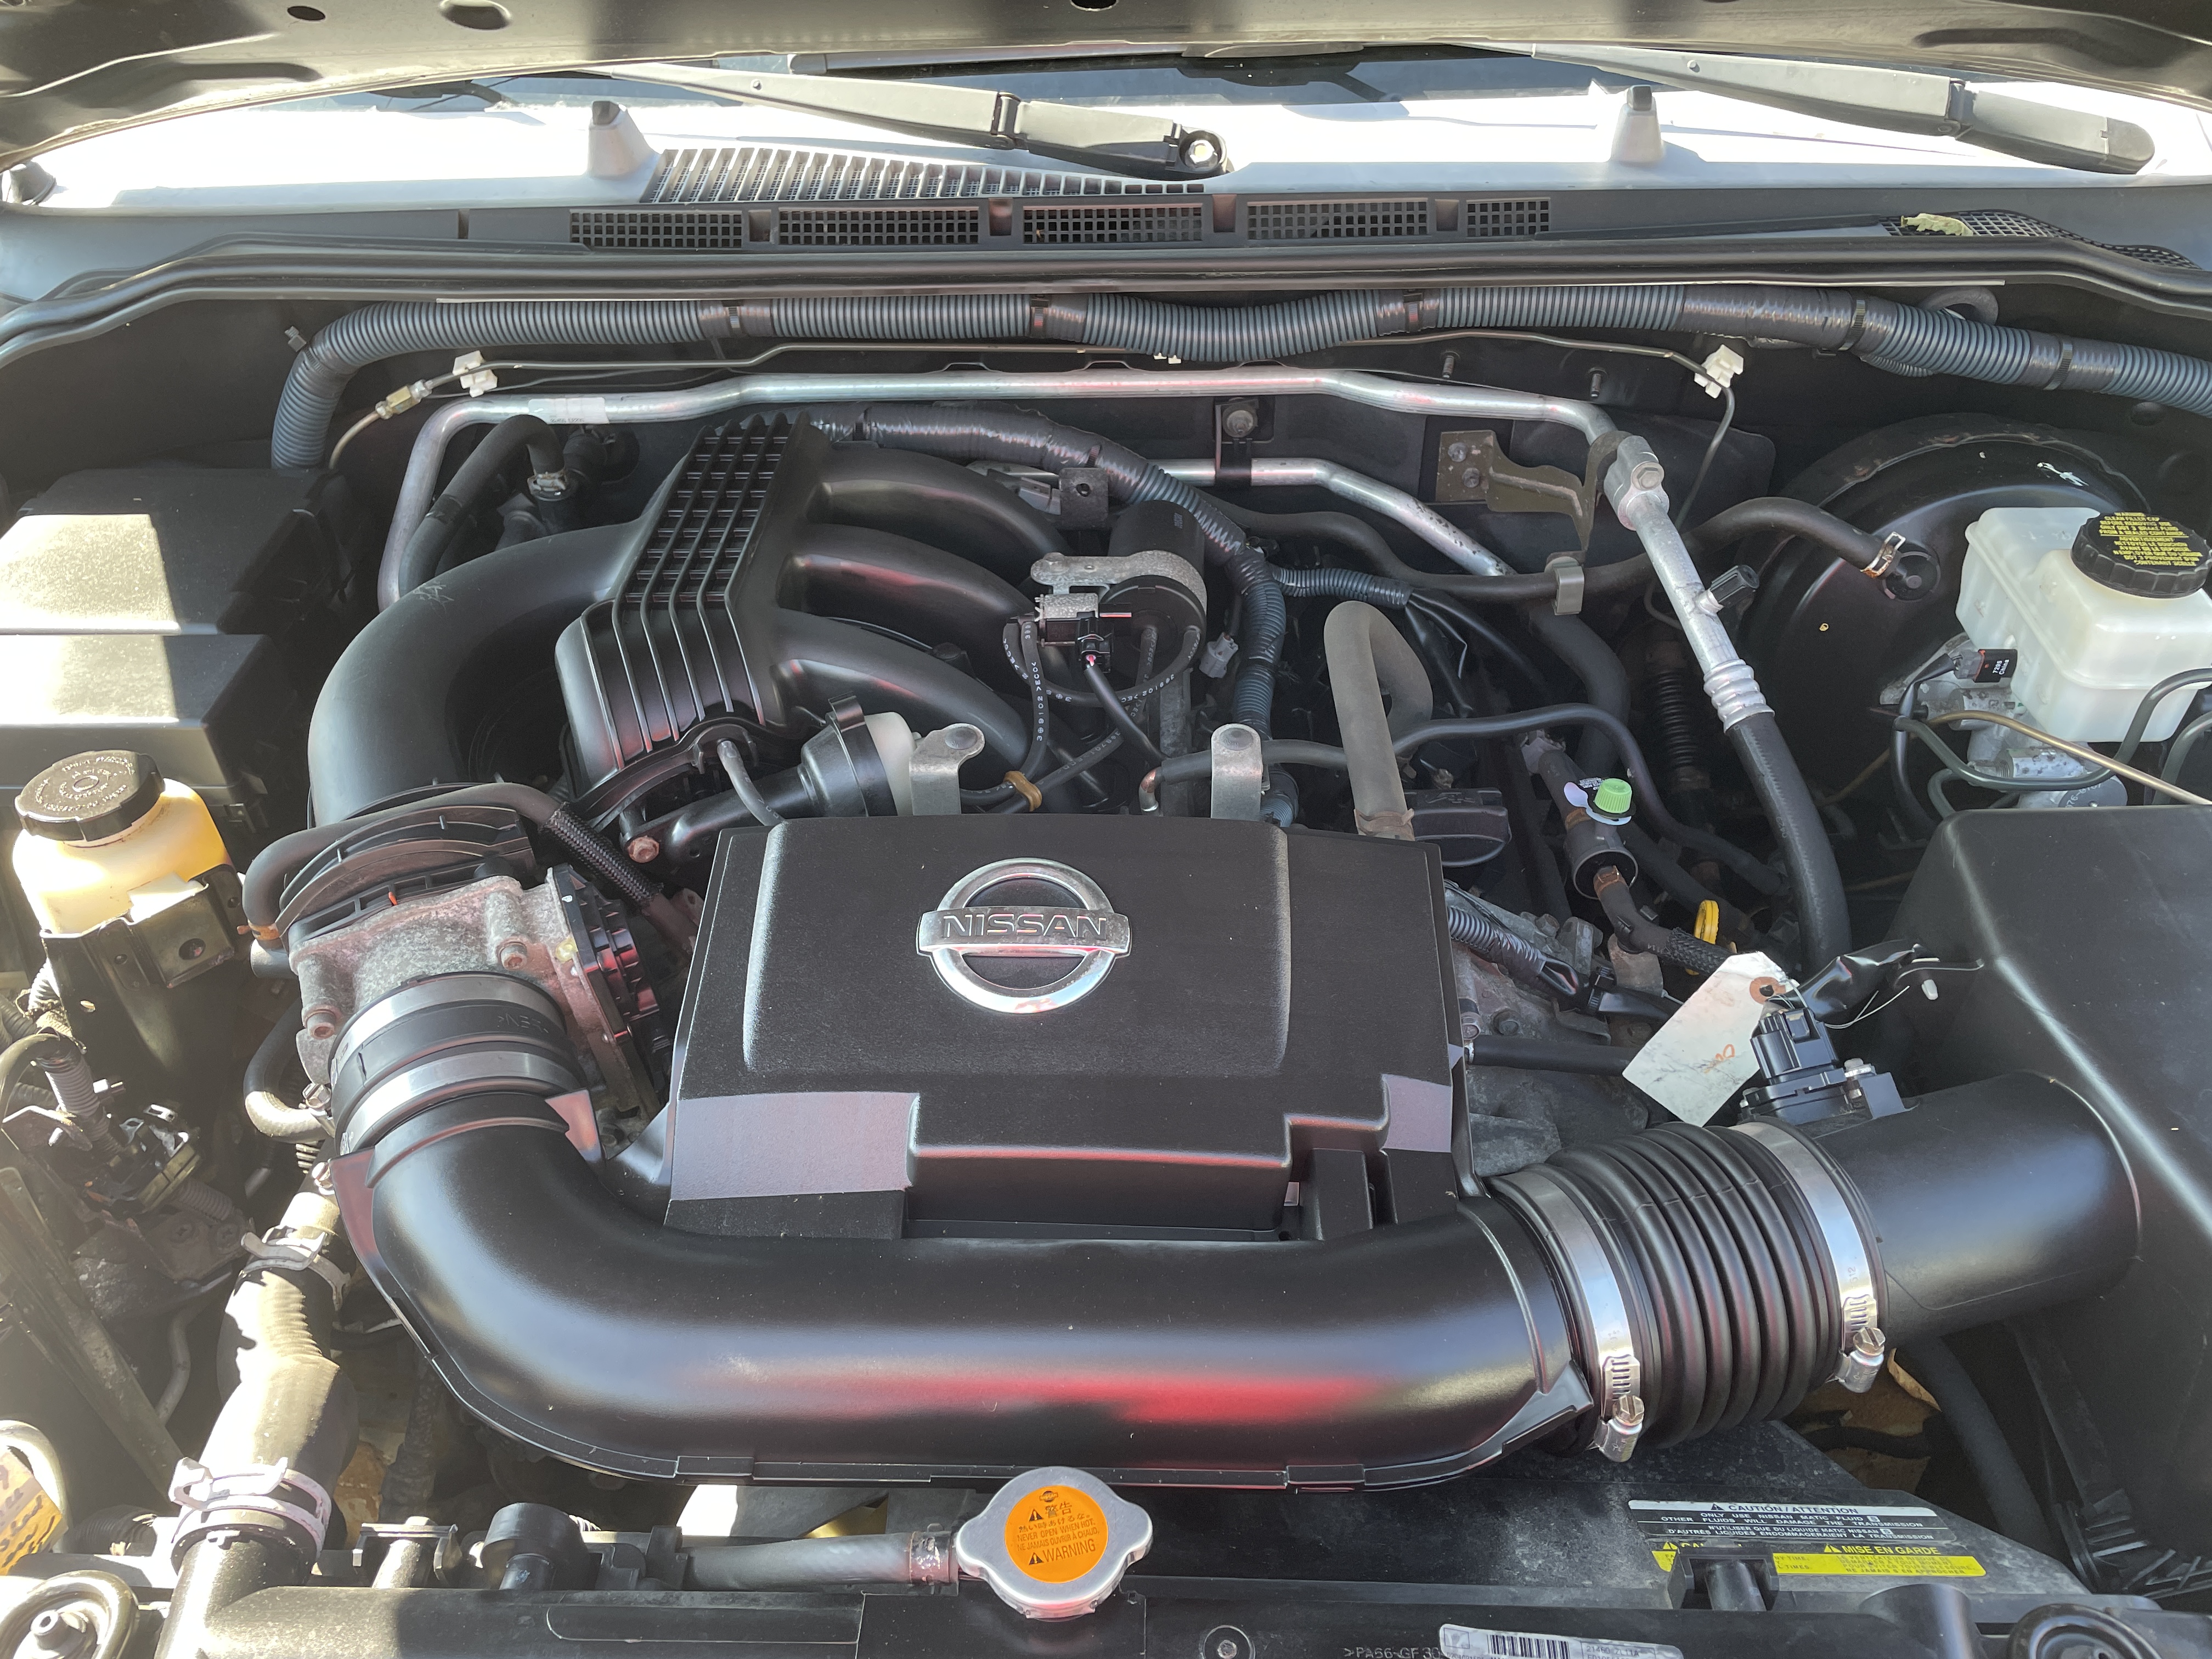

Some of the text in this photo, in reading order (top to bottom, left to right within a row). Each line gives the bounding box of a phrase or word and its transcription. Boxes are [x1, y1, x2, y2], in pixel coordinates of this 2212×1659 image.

[943, 914, 1107, 940] NISSAN
[1017, 1533, 1038, 1542] NEVER
[1041, 1527, 1058, 1538] OPEN
[1059, 1524, 1080, 1534] WHEN
[1026, 1539, 1049, 1550] JAMAIS
[1050, 1534, 1071, 1545] OUVRIR
[1042, 1538, 1096, 1562] WARNING
[1842, 1545, 1872, 1554] MISE
[1895, 1547, 1942, 1555] GARDE
